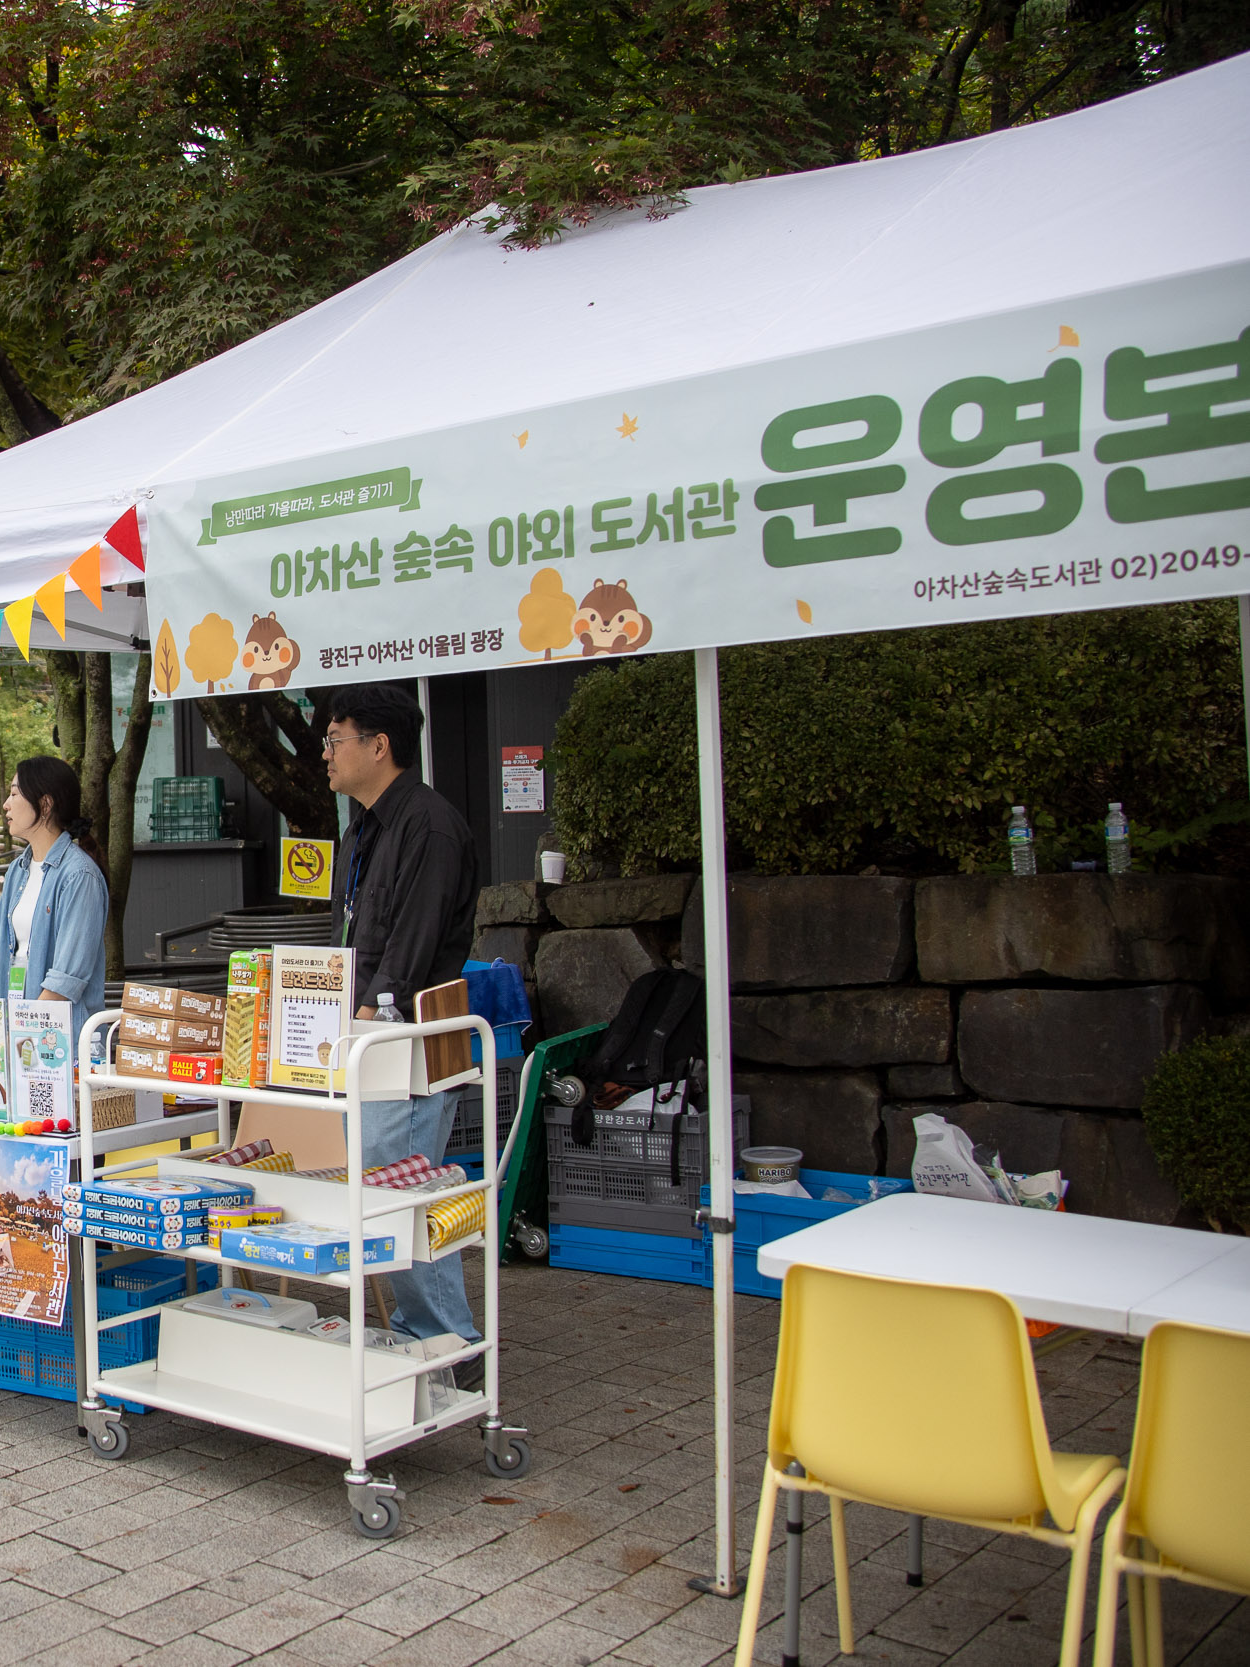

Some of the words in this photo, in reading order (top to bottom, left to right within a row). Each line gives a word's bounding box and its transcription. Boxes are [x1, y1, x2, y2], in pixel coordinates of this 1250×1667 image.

[225, 505, 265, 528] 낭만따라
[269, 496, 316, 517] 가을따라,
[318, 489, 355, 508] 도서관
[357, 481, 394, 503] 즐기기
[270, 537, 383, 598] 아차산
[393, 523, 474, 584] 숲속
[488, 512, 575, 568] 야외
[590, 477, 740, 555] 도서관
[914, 557, 1103, 603] 아차산숲속도서관
[1111, 543, 1250, 580] 02)2049-
[319, 645, 364, 669] 광진구
[368, 638, 414, 664] 아차산
[418, 632, 466, 659] 어울림
[470, 627, 504, 653] 광장
[281, 970, 343, 991] 빌려드려요
[172, 1060, 194, 1069] HALLI
[172, 1069, 193, 1077] GALLI
[594, 1113, 657, 1127] 양한강도서
[758, 1168, 792, 1177] HARIBO
[915, 1172, 972, 1187] 광진구립도서관
[84, 1191, 101, 1204] 게임
[102, 1193, 144, 1211] 다이아몬드
[86, 1207, 103, 1220] 게임
[104, 1210, 146, 1228] 다이아몬드
[86, 1224, 103, 1236] 게임
[104, 1226, 146, 1245] 다이아몬드
[45, 1224, 67, 1319] 야외도서관
